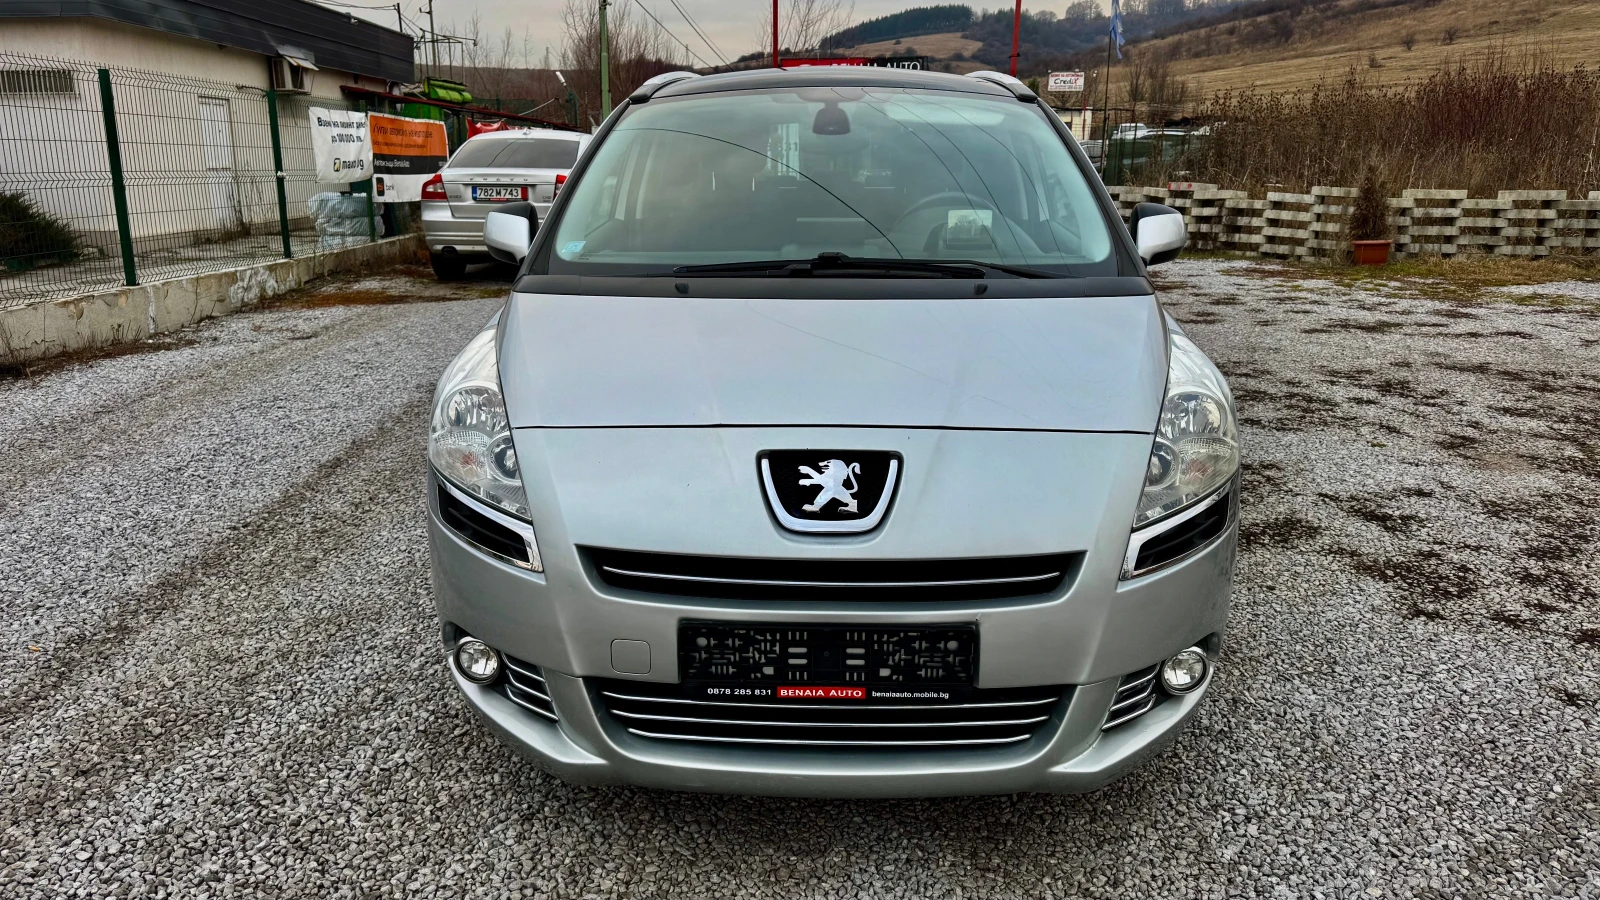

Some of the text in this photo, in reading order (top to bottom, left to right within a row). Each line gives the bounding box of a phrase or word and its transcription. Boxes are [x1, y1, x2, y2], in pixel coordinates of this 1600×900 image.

[707, 687, 731, 695] 0878
[829, 689, 862, 697] AUTO
[872, 690, 949, 699] benaiaauto.mobile.bg
